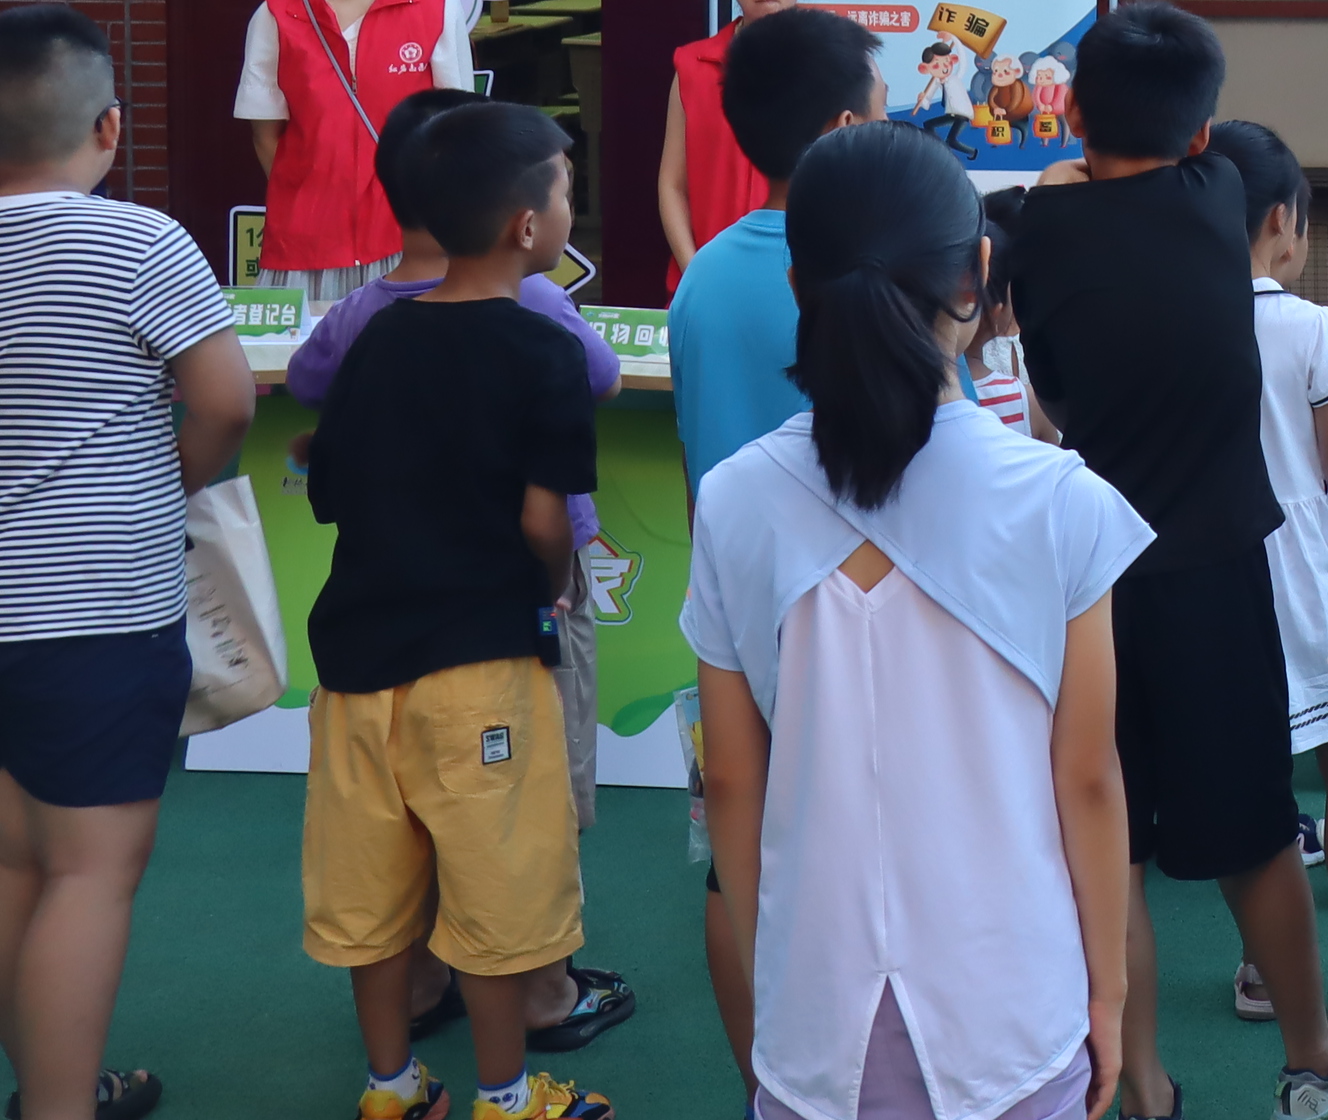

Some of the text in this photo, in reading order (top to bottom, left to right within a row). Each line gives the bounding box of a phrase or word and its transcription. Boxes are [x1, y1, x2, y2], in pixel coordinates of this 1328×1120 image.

[937, 6, 990, 38] 诈骗
[230, 303, 296, 326] 者登记台
